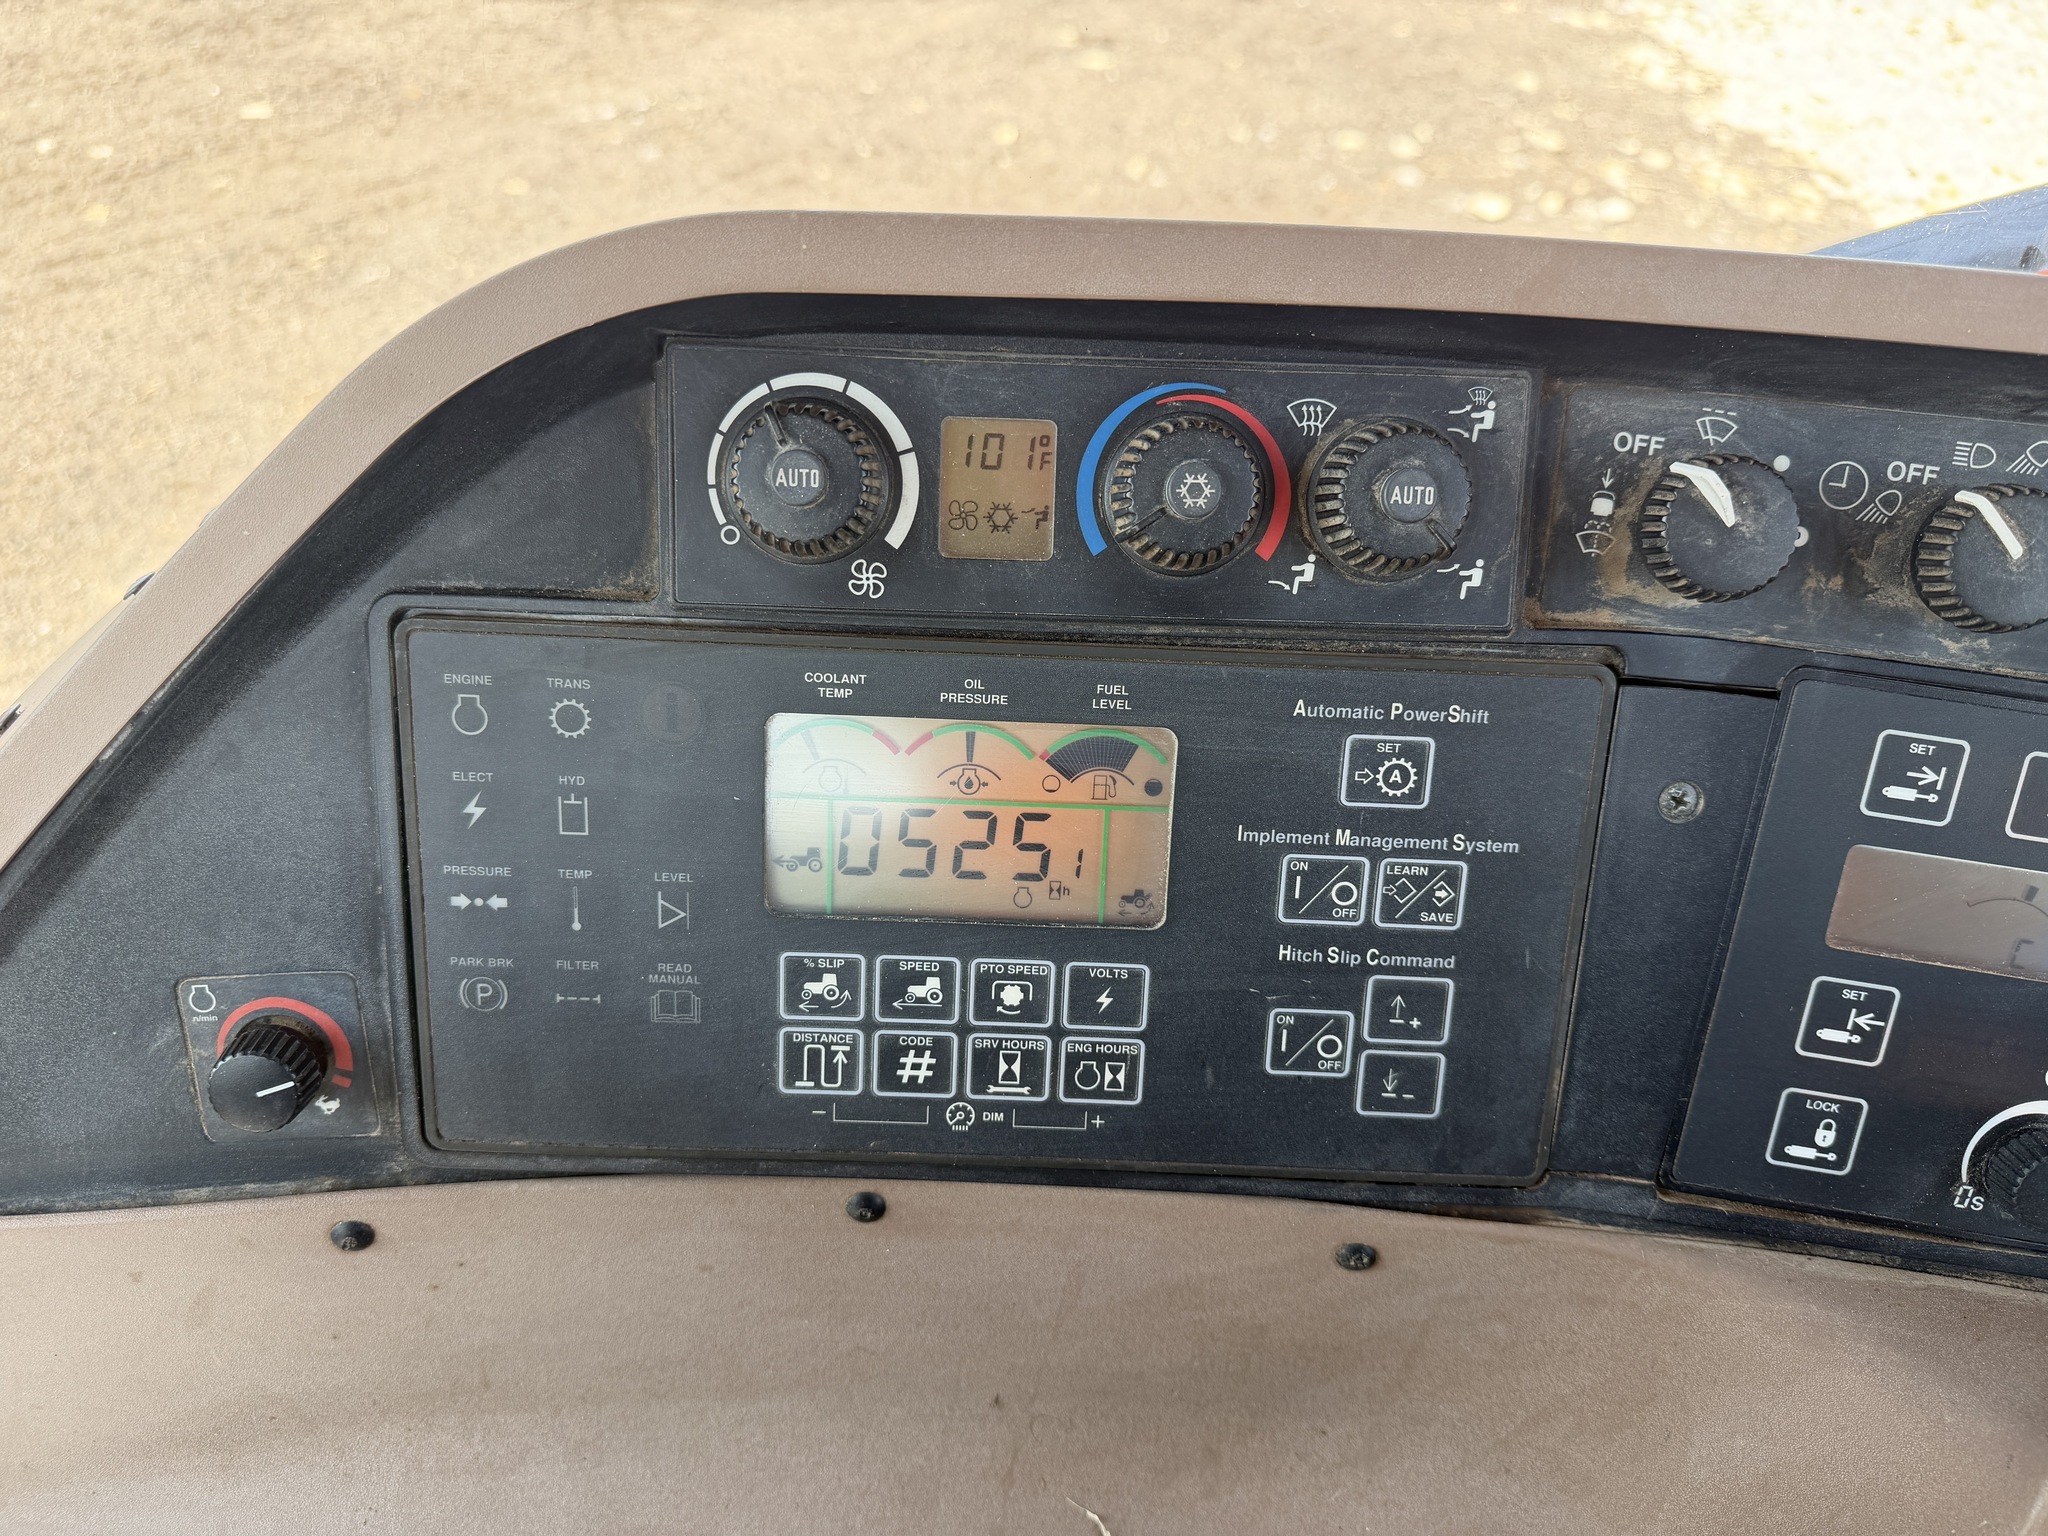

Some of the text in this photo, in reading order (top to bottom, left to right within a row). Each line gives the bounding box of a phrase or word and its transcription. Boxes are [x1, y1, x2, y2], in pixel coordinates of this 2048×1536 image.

[1612, 431, 1665, 456] OFF
[775, 467, 820, 488] AUTO
[1886, 460, 1940, 485] OFF
[1390, 486, 1434, 506] AUTO
[444, 673, 493, 686] ENGINE
[547, 678, 591, 690] TRANS
[804, 672, 867, 685] COOLANT
[964, 679, 985, 690] OIL
[818, 687, 853, 699] TEMP
[1097, 684, 1129, 696] FUEL
[940, 692, 1008, 705] PRESSURE
[1092, 698, 1132, 711] LEVEL
[1293, 699, 1490, 724] Automatic PowerShift
[1376, 742, 1402, 754] SET
[1909, 742, 1936, 757] SET
[452, 771, 494, 783] ELECT
[559, 776, 585, 787] HYD
[1237, 825, 1520, 855] Implement Management System
[443, 865, 512, 878] PRESSURE
[1290, 861, 1308, 871] ON
[1386, 865, 1429, 877] LEARN
[558, 869, 593, 880] TEMP
[654, 872, 694, 883] LEVEL
[1332, 908, 1357, 918] OFF
[1420, 911, 1454, 923] SAVE
[450, 957, 514, 968] PARK BRK
[1278, 944, 1455, 969] Hitch Slip Command
[556, 960, 600, 971] FILTER
[657, 963, 693, 974] READ
[803, 958, 845, 971] % SLIP
[899, 960, 941, 973] SPEED
[979, 963, 1049, 977] PTO SPEED
[649, 974, 701, 985] MANUAL
[1088, 967, 1129, 980] VOLTS
[1841, 988, 1868, 1002] SET
[192, 1014, 218, 1023] n/min
[1276, 1014, 1295, 1026] ON
[792, 1032, 854, 1045] DISTANCE
[899, 1035, 934, 1047] CODE
[974, 1037, 1045, 1052] SRV HOURS
[1066, 1042, 1139, 1057] ENG HOURS
[1317, 1058, 1343, 1071] OFF
[1805, 1098, 1840, 1114] LOCK
[982, 1111, 1005, 1122] DIM
